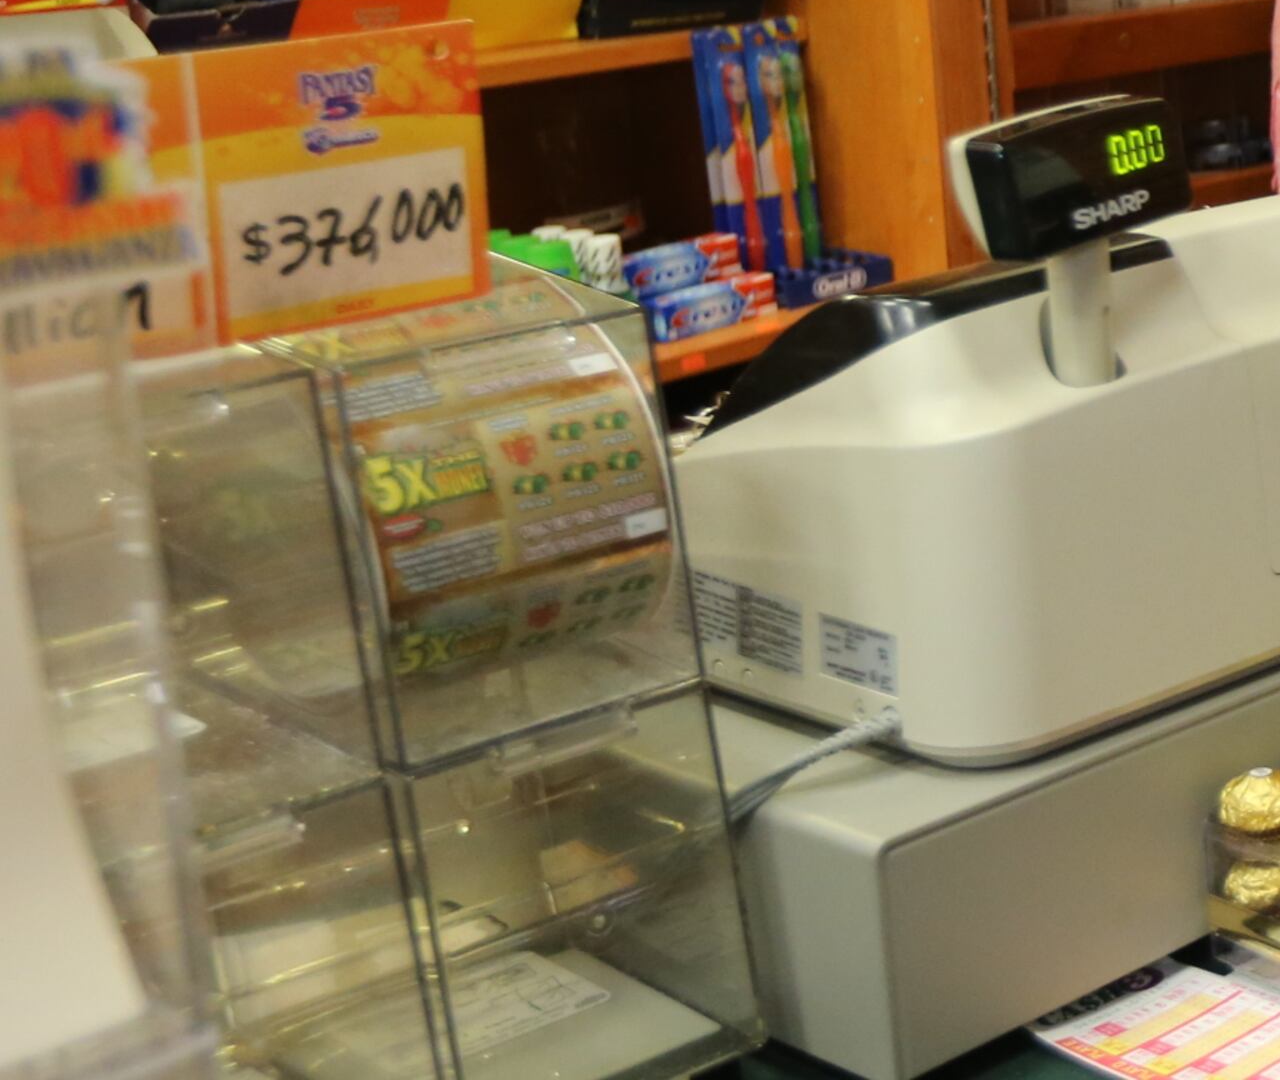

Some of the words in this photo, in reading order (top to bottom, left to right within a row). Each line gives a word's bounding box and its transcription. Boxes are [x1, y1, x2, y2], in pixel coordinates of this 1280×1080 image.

[299, 66, 376, 103] FANTASY
[321, 94, 362, 121] 5
[1106, 124, 1165, 176] 0.00
[241, 181, 464, 277] $376,000
[1072, 188, 1150, 231] SHARP
[364, 455, 437, 515] 5X
